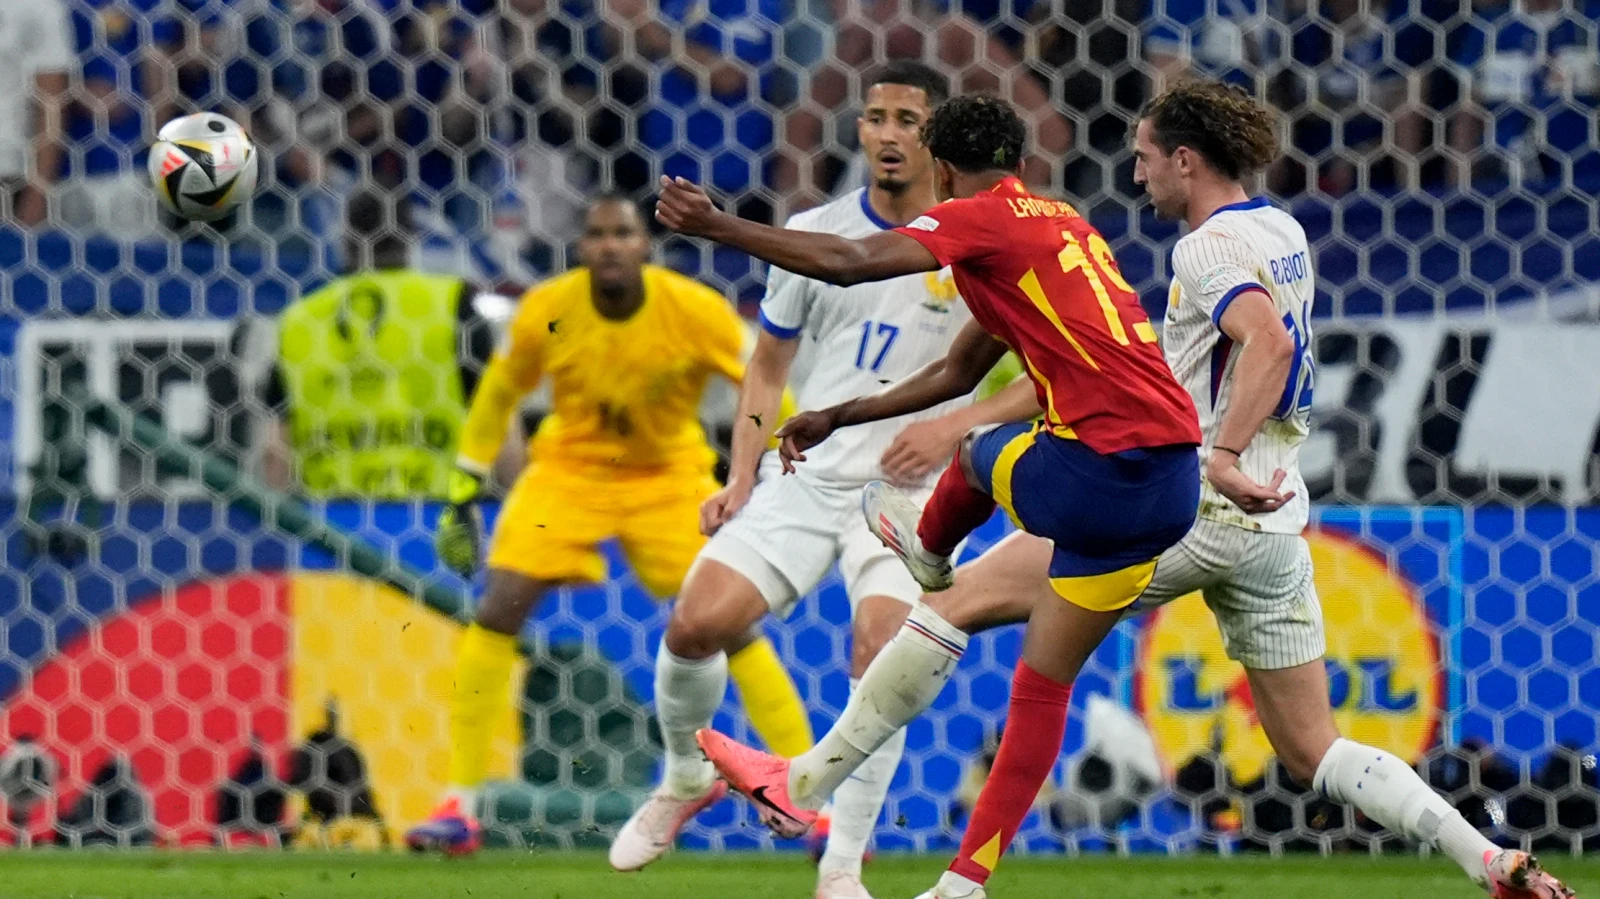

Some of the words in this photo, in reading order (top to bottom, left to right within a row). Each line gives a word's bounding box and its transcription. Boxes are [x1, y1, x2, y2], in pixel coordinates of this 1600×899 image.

[1058, 231, 1157, 346] 19
[1270, 251, 1307, 285] RBIOT
[855, 320, 900, 373] 17
[1163, 656, 1418, 712] LDL
